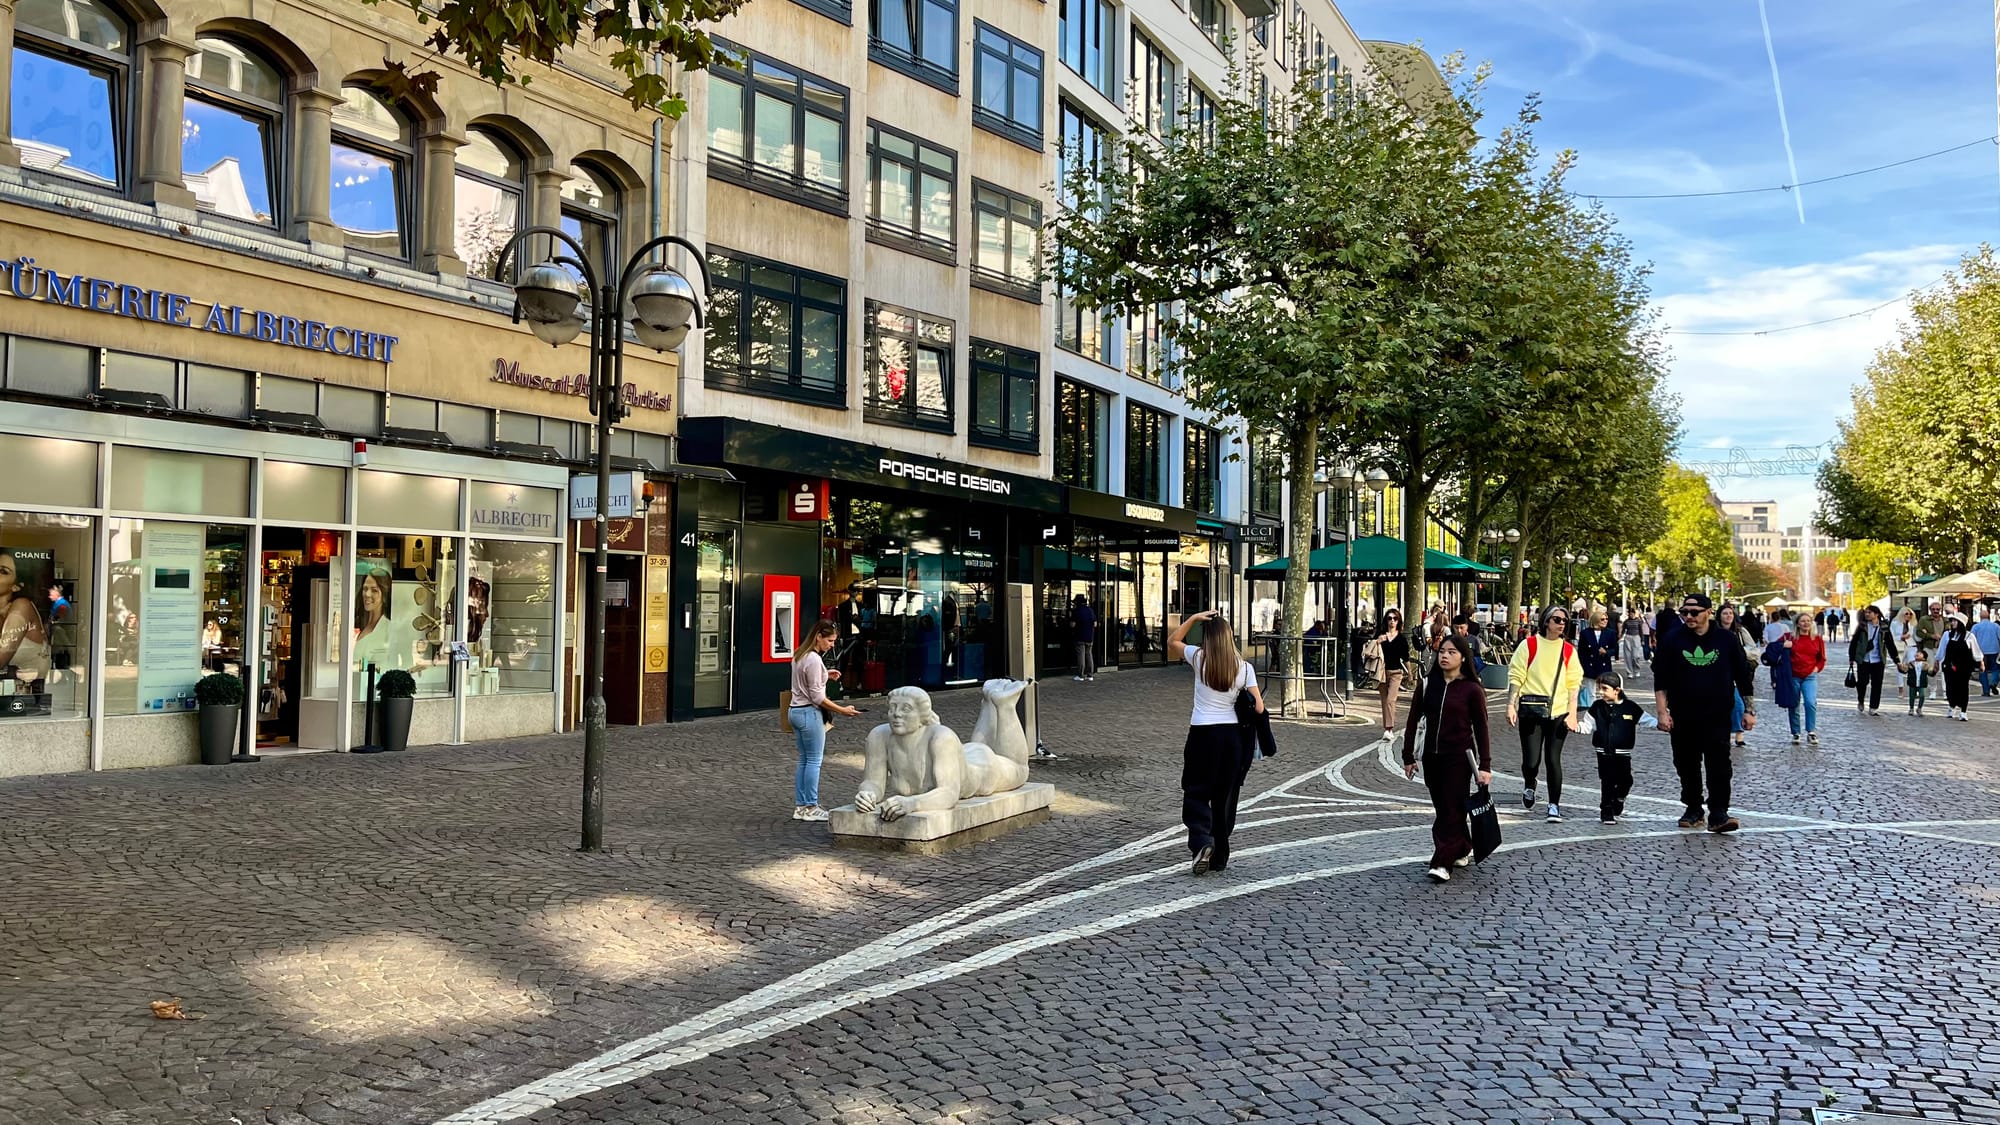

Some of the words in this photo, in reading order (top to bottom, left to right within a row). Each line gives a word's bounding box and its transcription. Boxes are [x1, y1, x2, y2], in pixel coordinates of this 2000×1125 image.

[0, 256, 192, 327] ÜMERIE
[204, 302, 399, 363] ALBRECHT
[490, 357, 570, 394] Muscat
[879, 458, 956, 486] PORSCHE
[960, 473, 1011, 495] DESIGN
[574, 494, 629, 509] ALBCHT
[471, 509, 552, 528] ALBRECHT
[1125, 503, 1165, 522] DSQUARED2
[680, 533, 695, 547] 41
[1240, 527, 1272, 537] LICCI
[14, 551, 51, 560] CHANEL
[649, 558, 667, 566] 37-39
